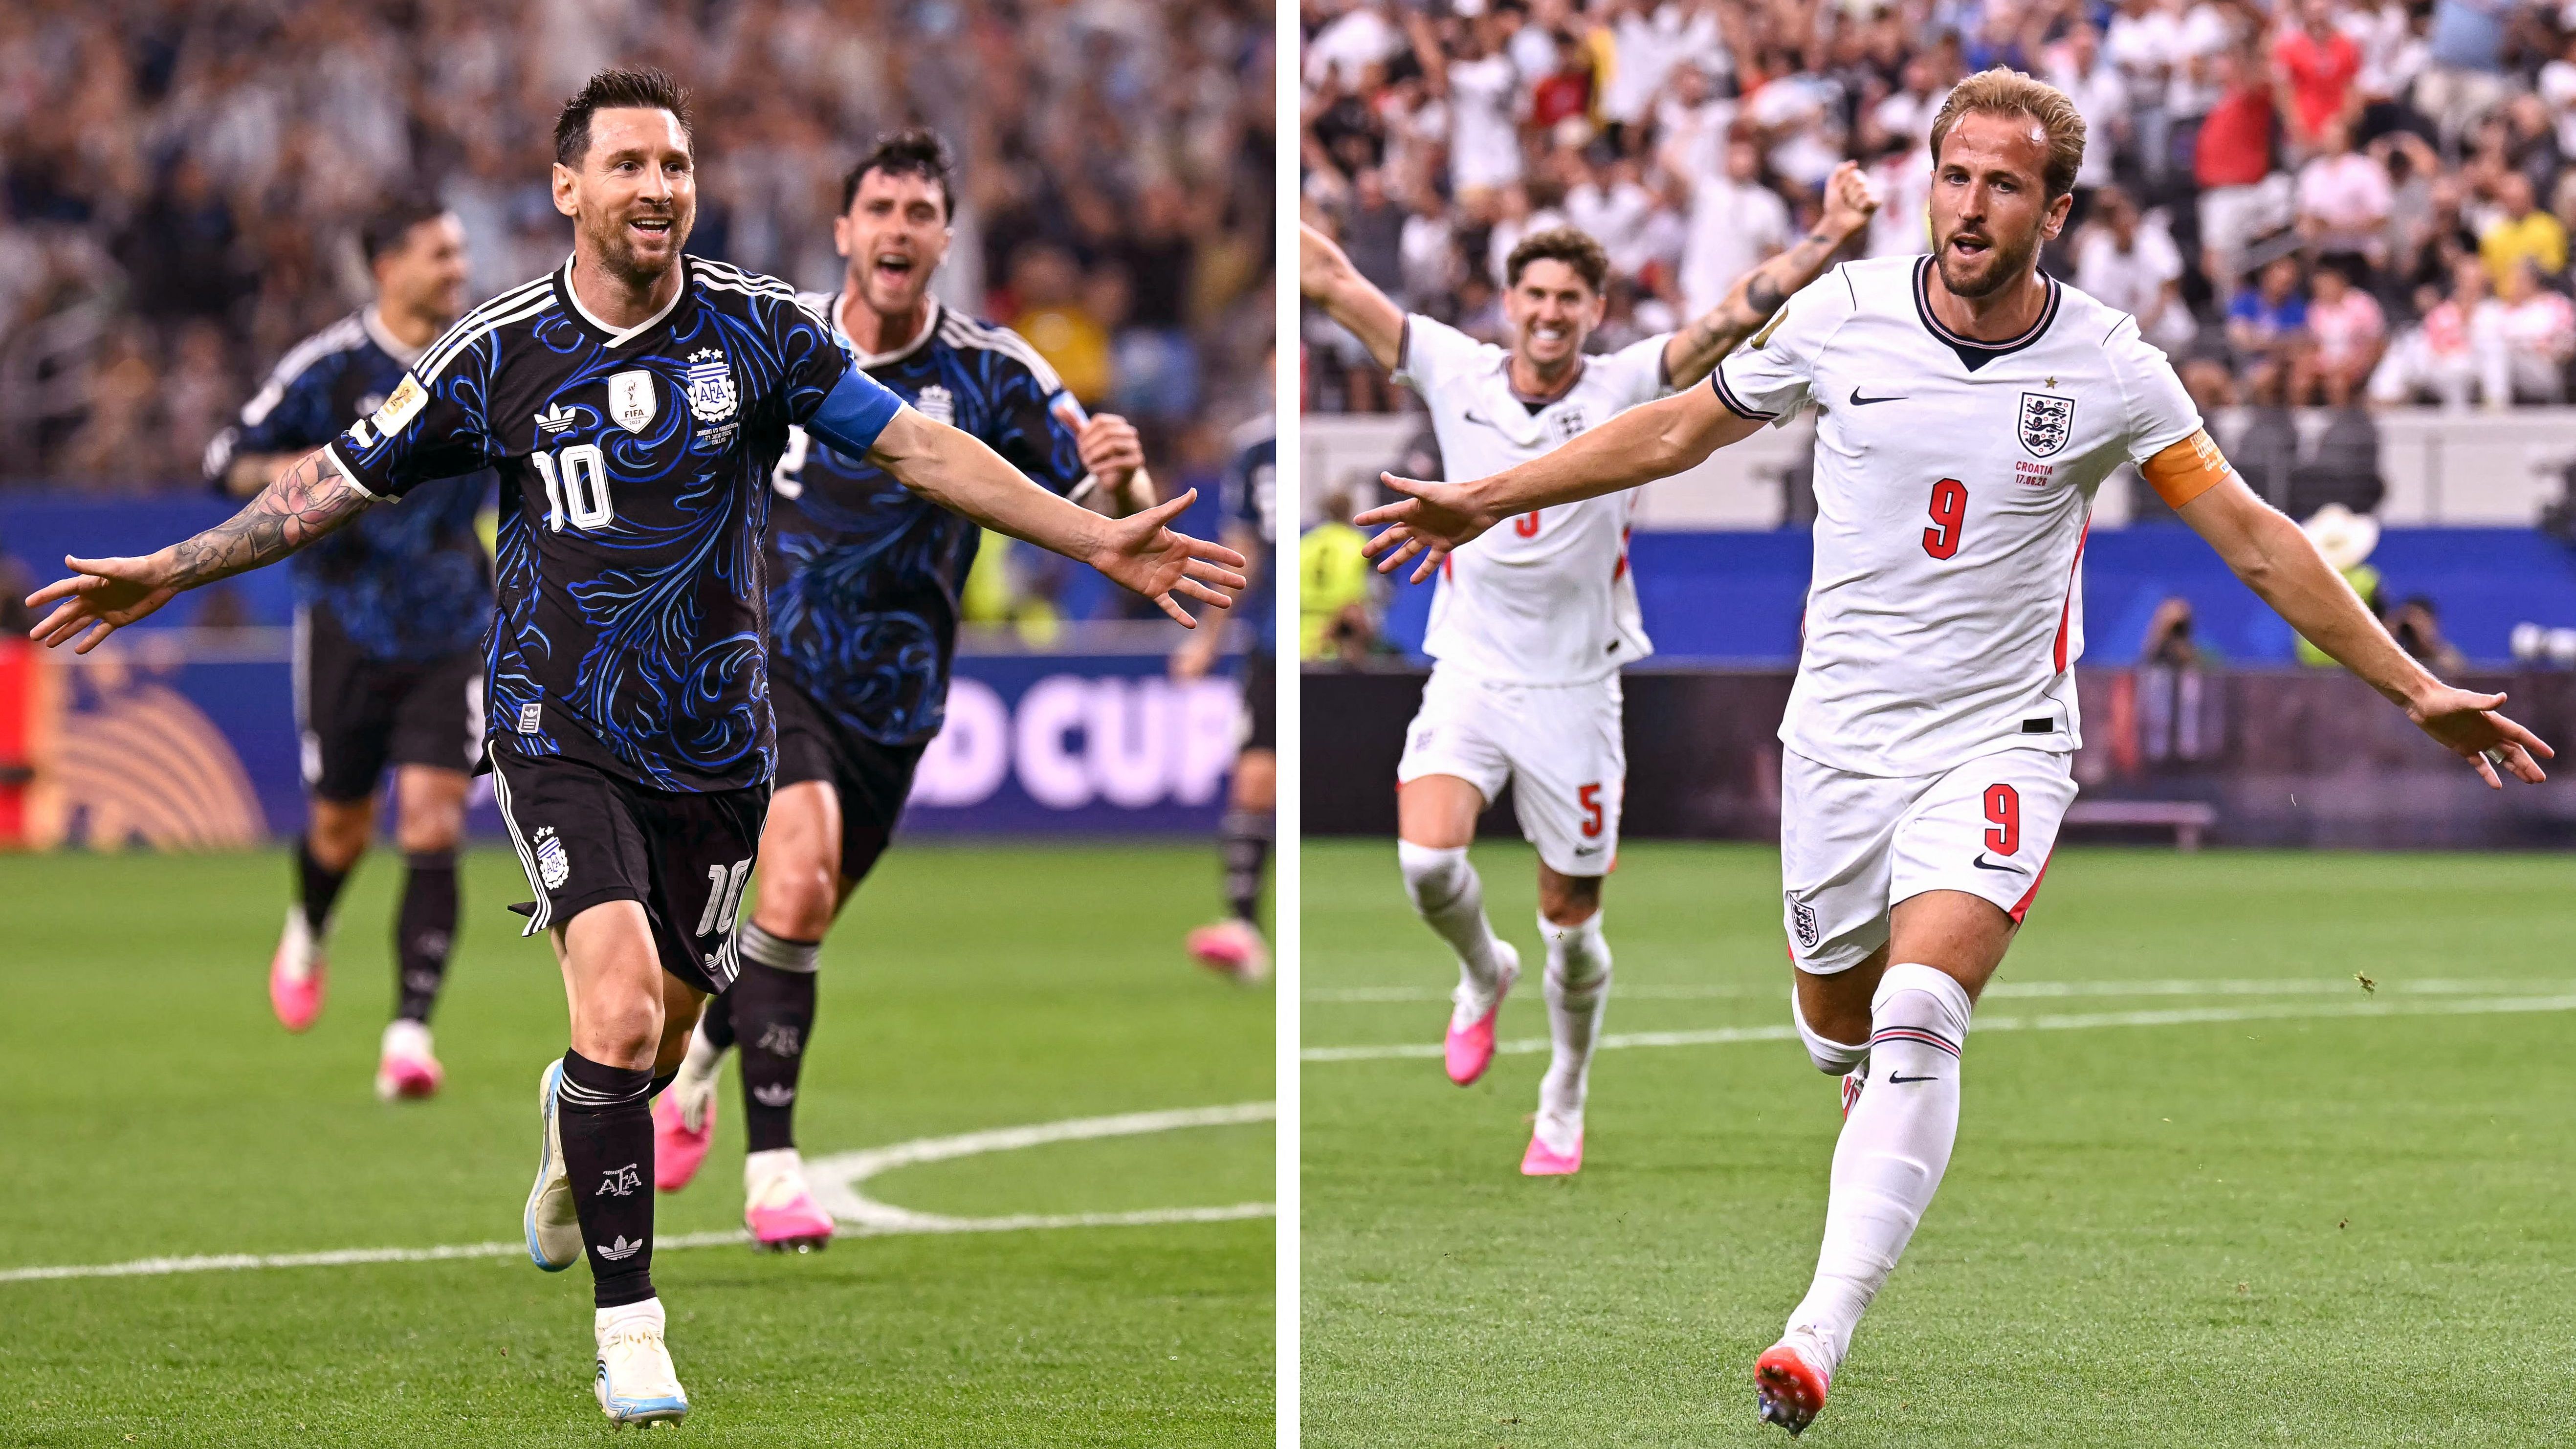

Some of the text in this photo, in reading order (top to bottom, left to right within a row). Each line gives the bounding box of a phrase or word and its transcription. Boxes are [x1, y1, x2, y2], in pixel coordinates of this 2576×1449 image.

[700, 378, 726, 403] AFA
[624, 409, 644, 418] FIFA
[719, 422, 738, 431] ARGENTINA
[2016, 461, 2053, 475] CROATIA
[2016, 474, 2048, 486] 17.06.26
[531, 443, 614, 533] 10
[1922, 478, 1968, 561] 9
[1014, 673, 1242, 812] CUP
[1578, 783, 1602, 838] 5
[1983, 784, 2020, 856] 9
[546, 852, 561, 874] AFA
[696, 855, 753, 937] 10
[596, 1163, 641, 1196] AFA
